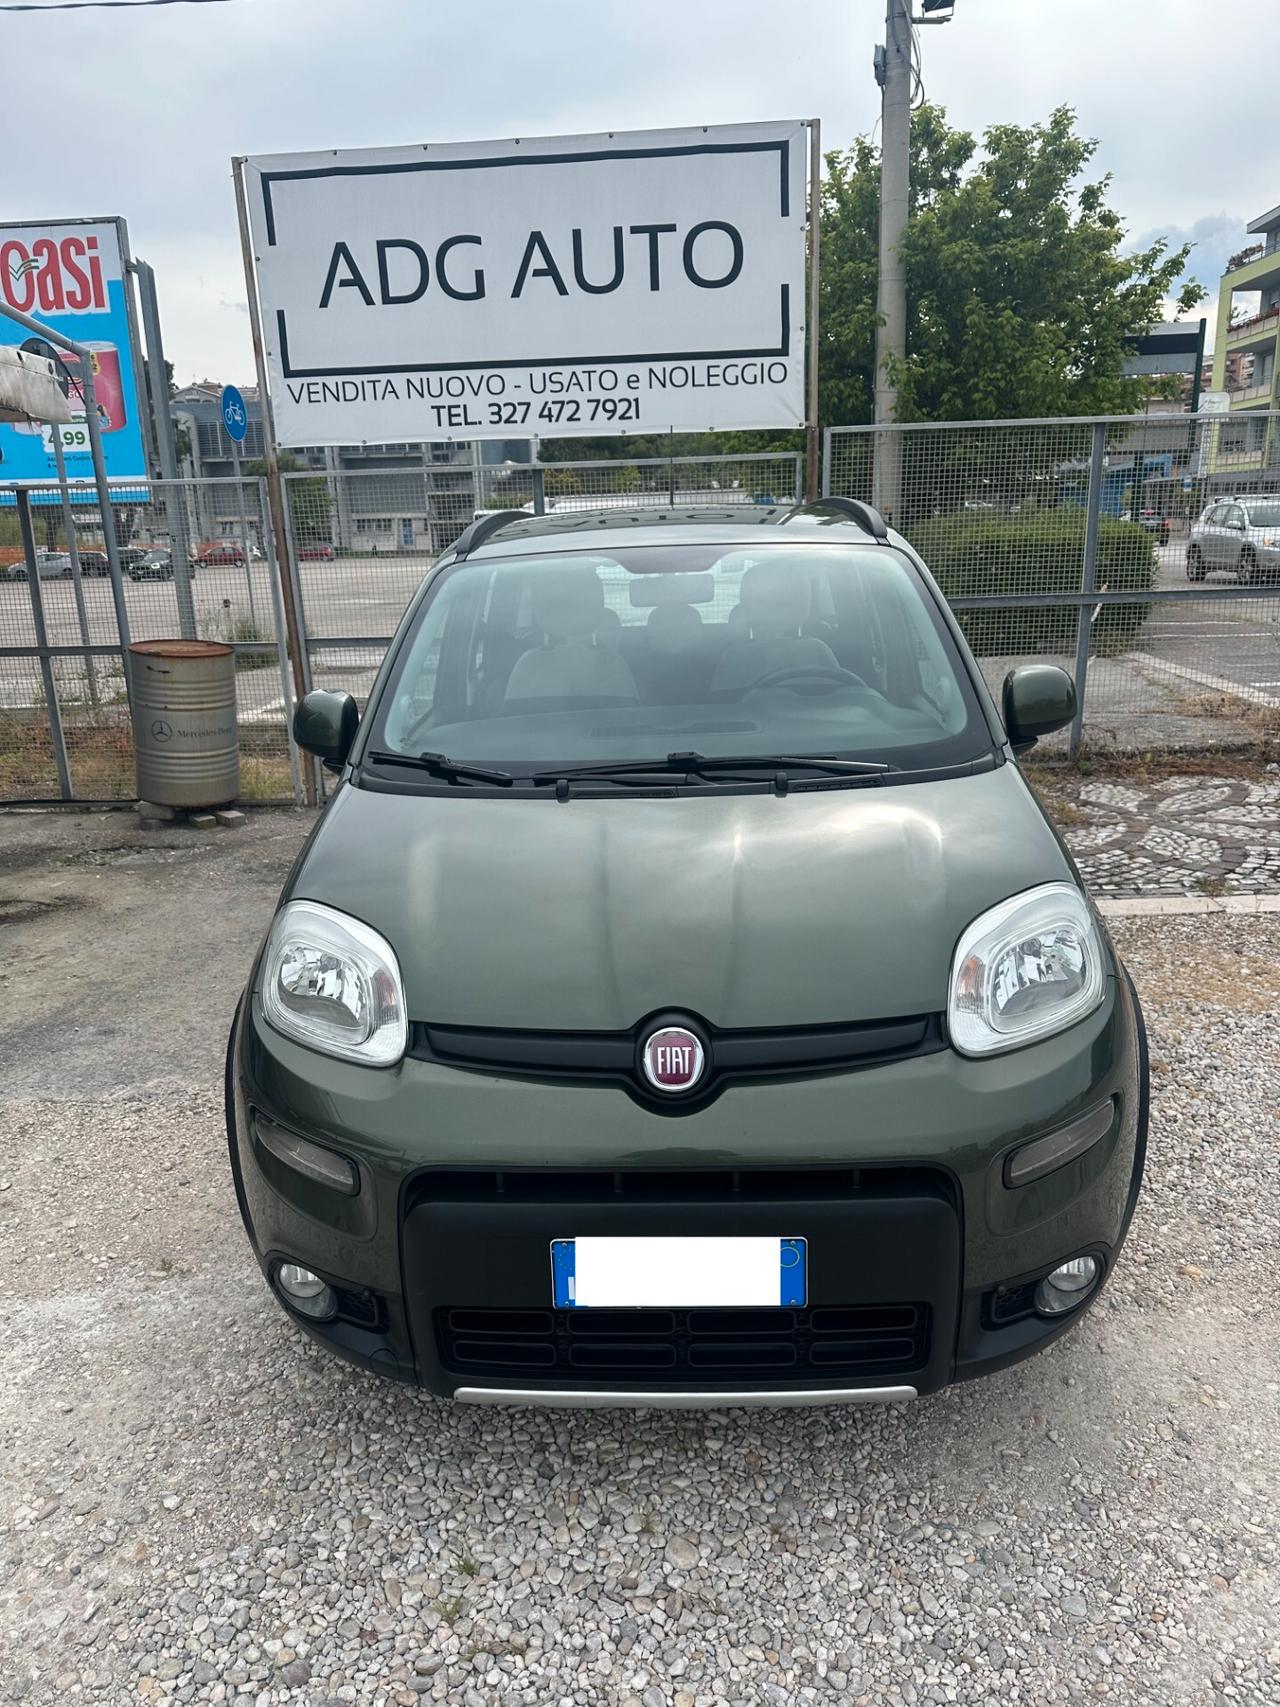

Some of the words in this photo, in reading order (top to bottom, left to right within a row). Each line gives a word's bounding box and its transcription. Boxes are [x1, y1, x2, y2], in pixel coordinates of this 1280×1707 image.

[319, 234, 486, 308] ADG
[510, 220, 745, 298] AUTO
[286, 379, 399, 404] VENDITA
[406, 374, 506, 400] NUOVO
[529, 369, 618, 395] USATO
[627, 375, 640, 389] e
[648, 361, 789, 389] NOLEGGIO
[431, 404, 482, 427] TEL.
[488, 402, 531, 425] 327
[538, 399, 581, 422] 472
[587, 397, 641, 421] 7921
[658, 1046, 692, 1075] FIAT
